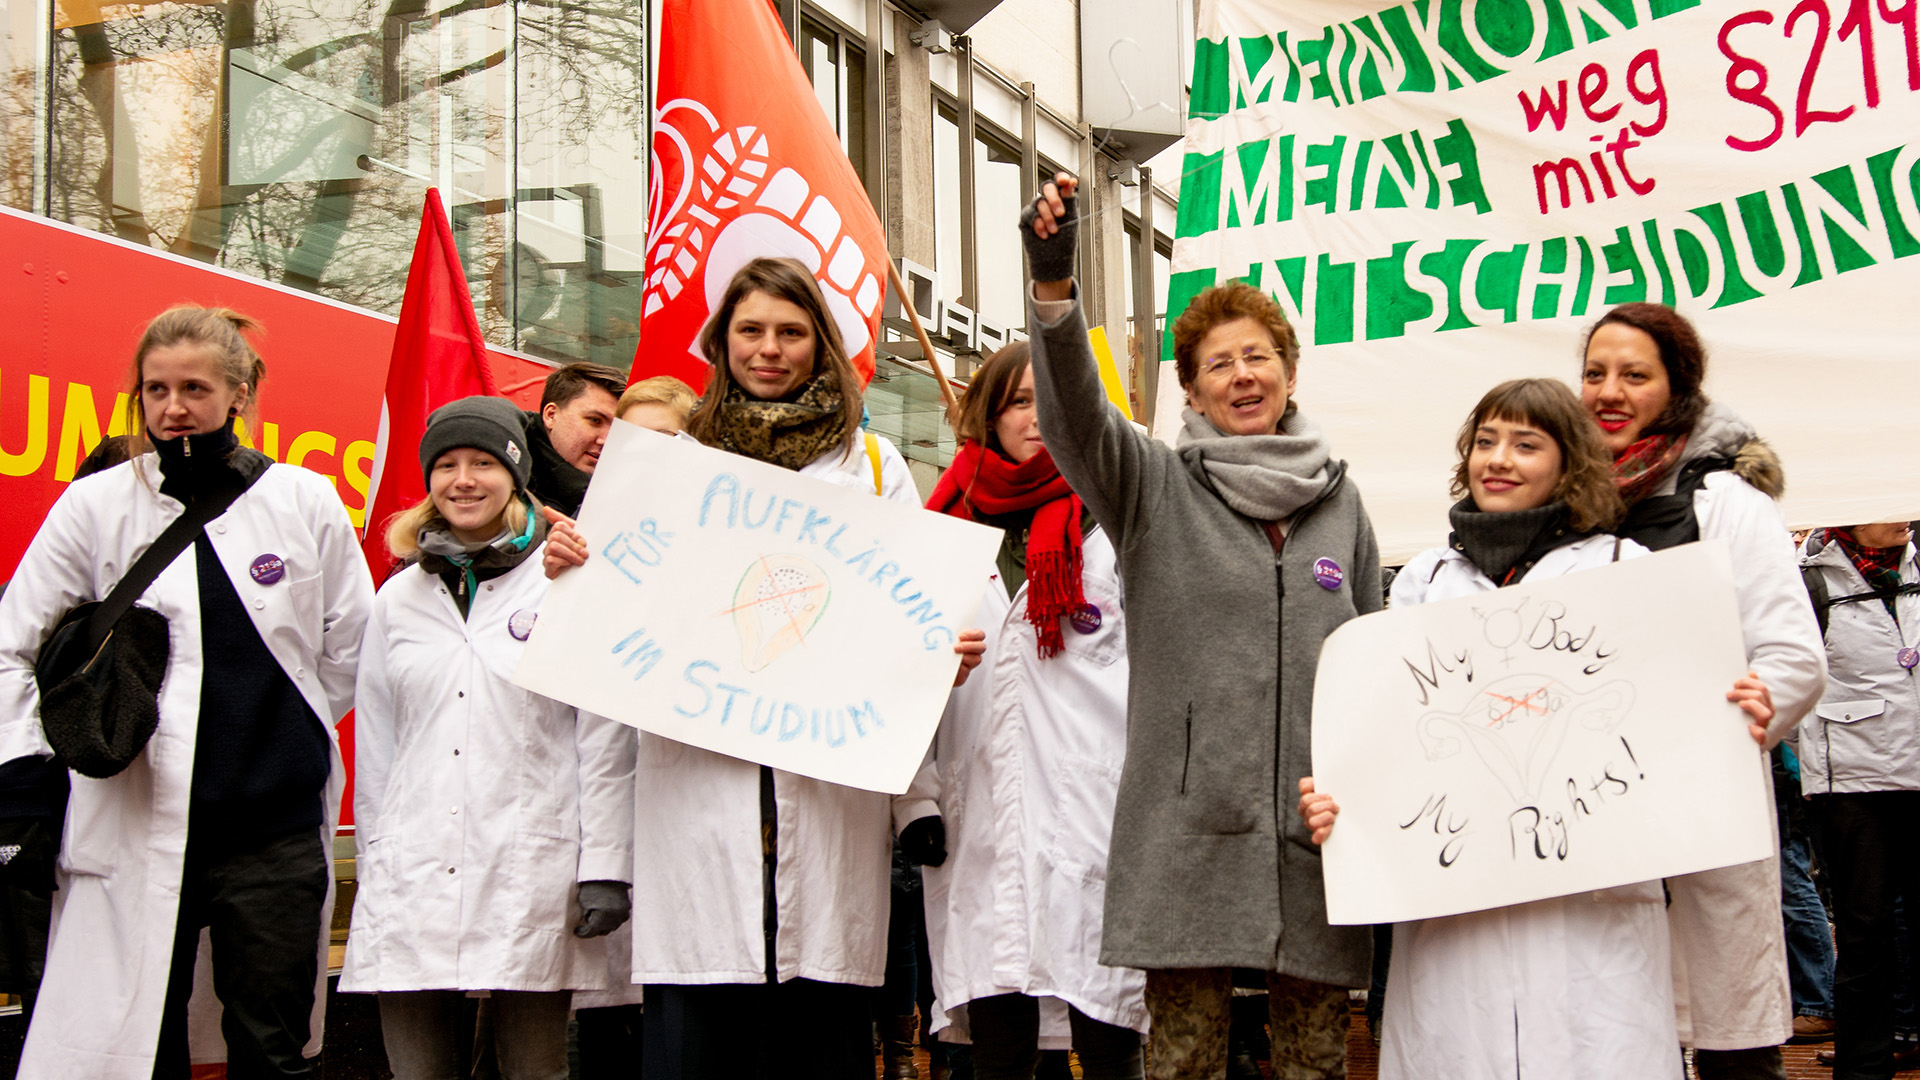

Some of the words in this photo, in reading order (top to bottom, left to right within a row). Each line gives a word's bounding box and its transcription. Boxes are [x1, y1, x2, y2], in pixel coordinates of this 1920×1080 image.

[1517, 48, 1668, 138] weg
[1217, 124, 1480, 232] MEINE
[1532, 127, 1656, 214] mit
[1215, 140, 1920, 346] NTSCHEIDUN
[602, 516, 676, 585] FÜR
[698, 472, 954, 651] AUFKLÄRUNG
[611, 627, 664, 682] IM
[673, 660, 885, 748] STUDIUM
[1401, 636, 1474, 706] My
[1524, 600, 1620, 676] Body
[1399, 793, 1476, 868] My
[1507, 736, 1645, 861] Rights!
